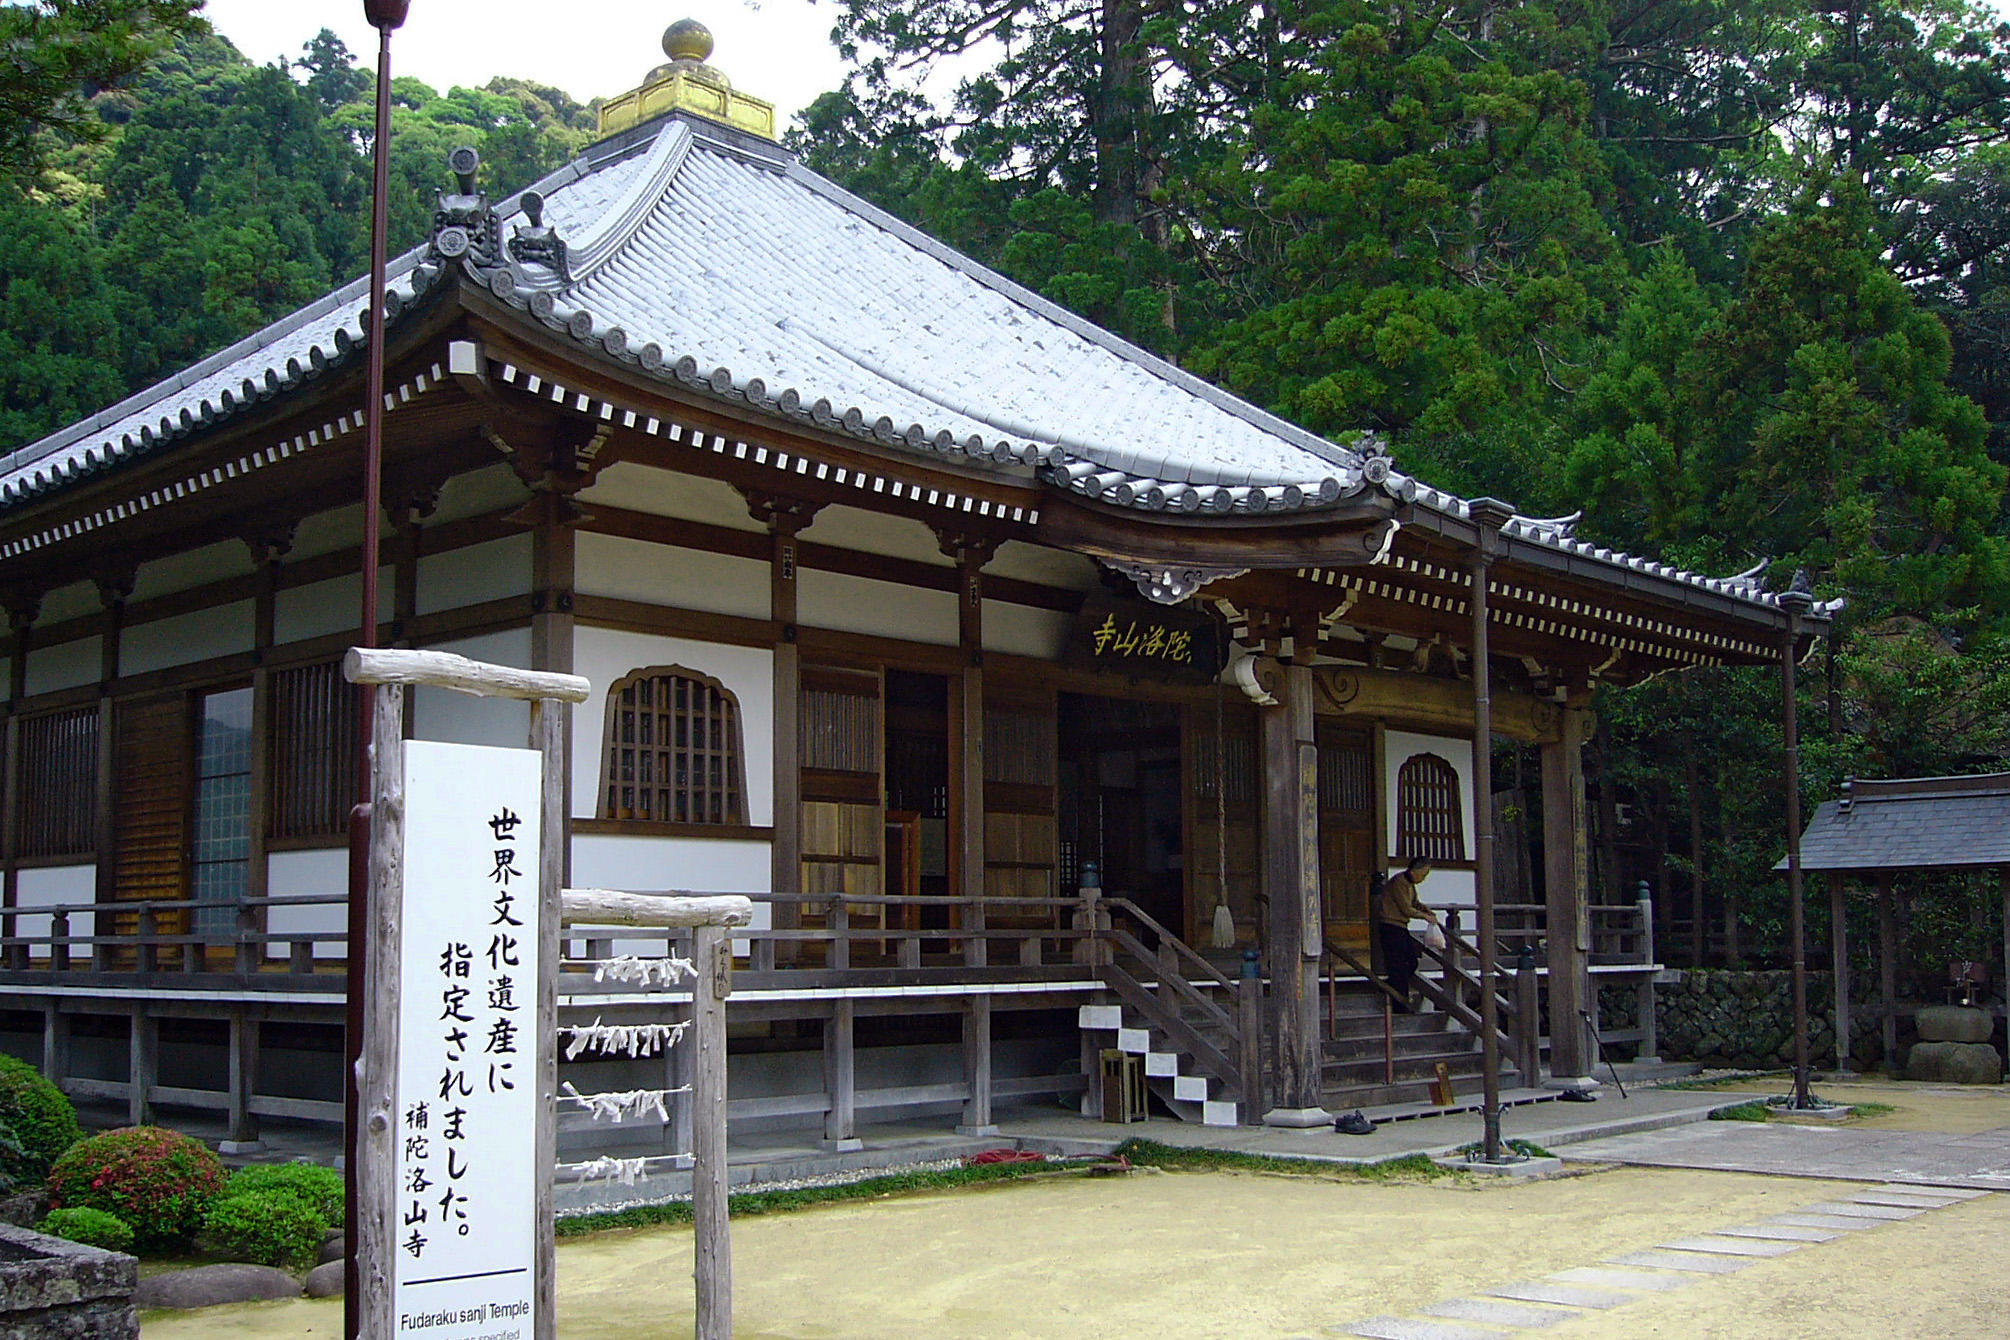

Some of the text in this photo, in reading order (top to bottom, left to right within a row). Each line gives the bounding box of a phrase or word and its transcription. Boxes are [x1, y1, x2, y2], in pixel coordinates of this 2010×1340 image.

[484, 806, 523, 1093] 世界文化遺産に
[402, 1101, 434, 1258] 補陀洛山寺
[438, 942, 475, 1236] 指定されました。
[401, 1299, 530, 1331] Fudaraku sanji Temple
